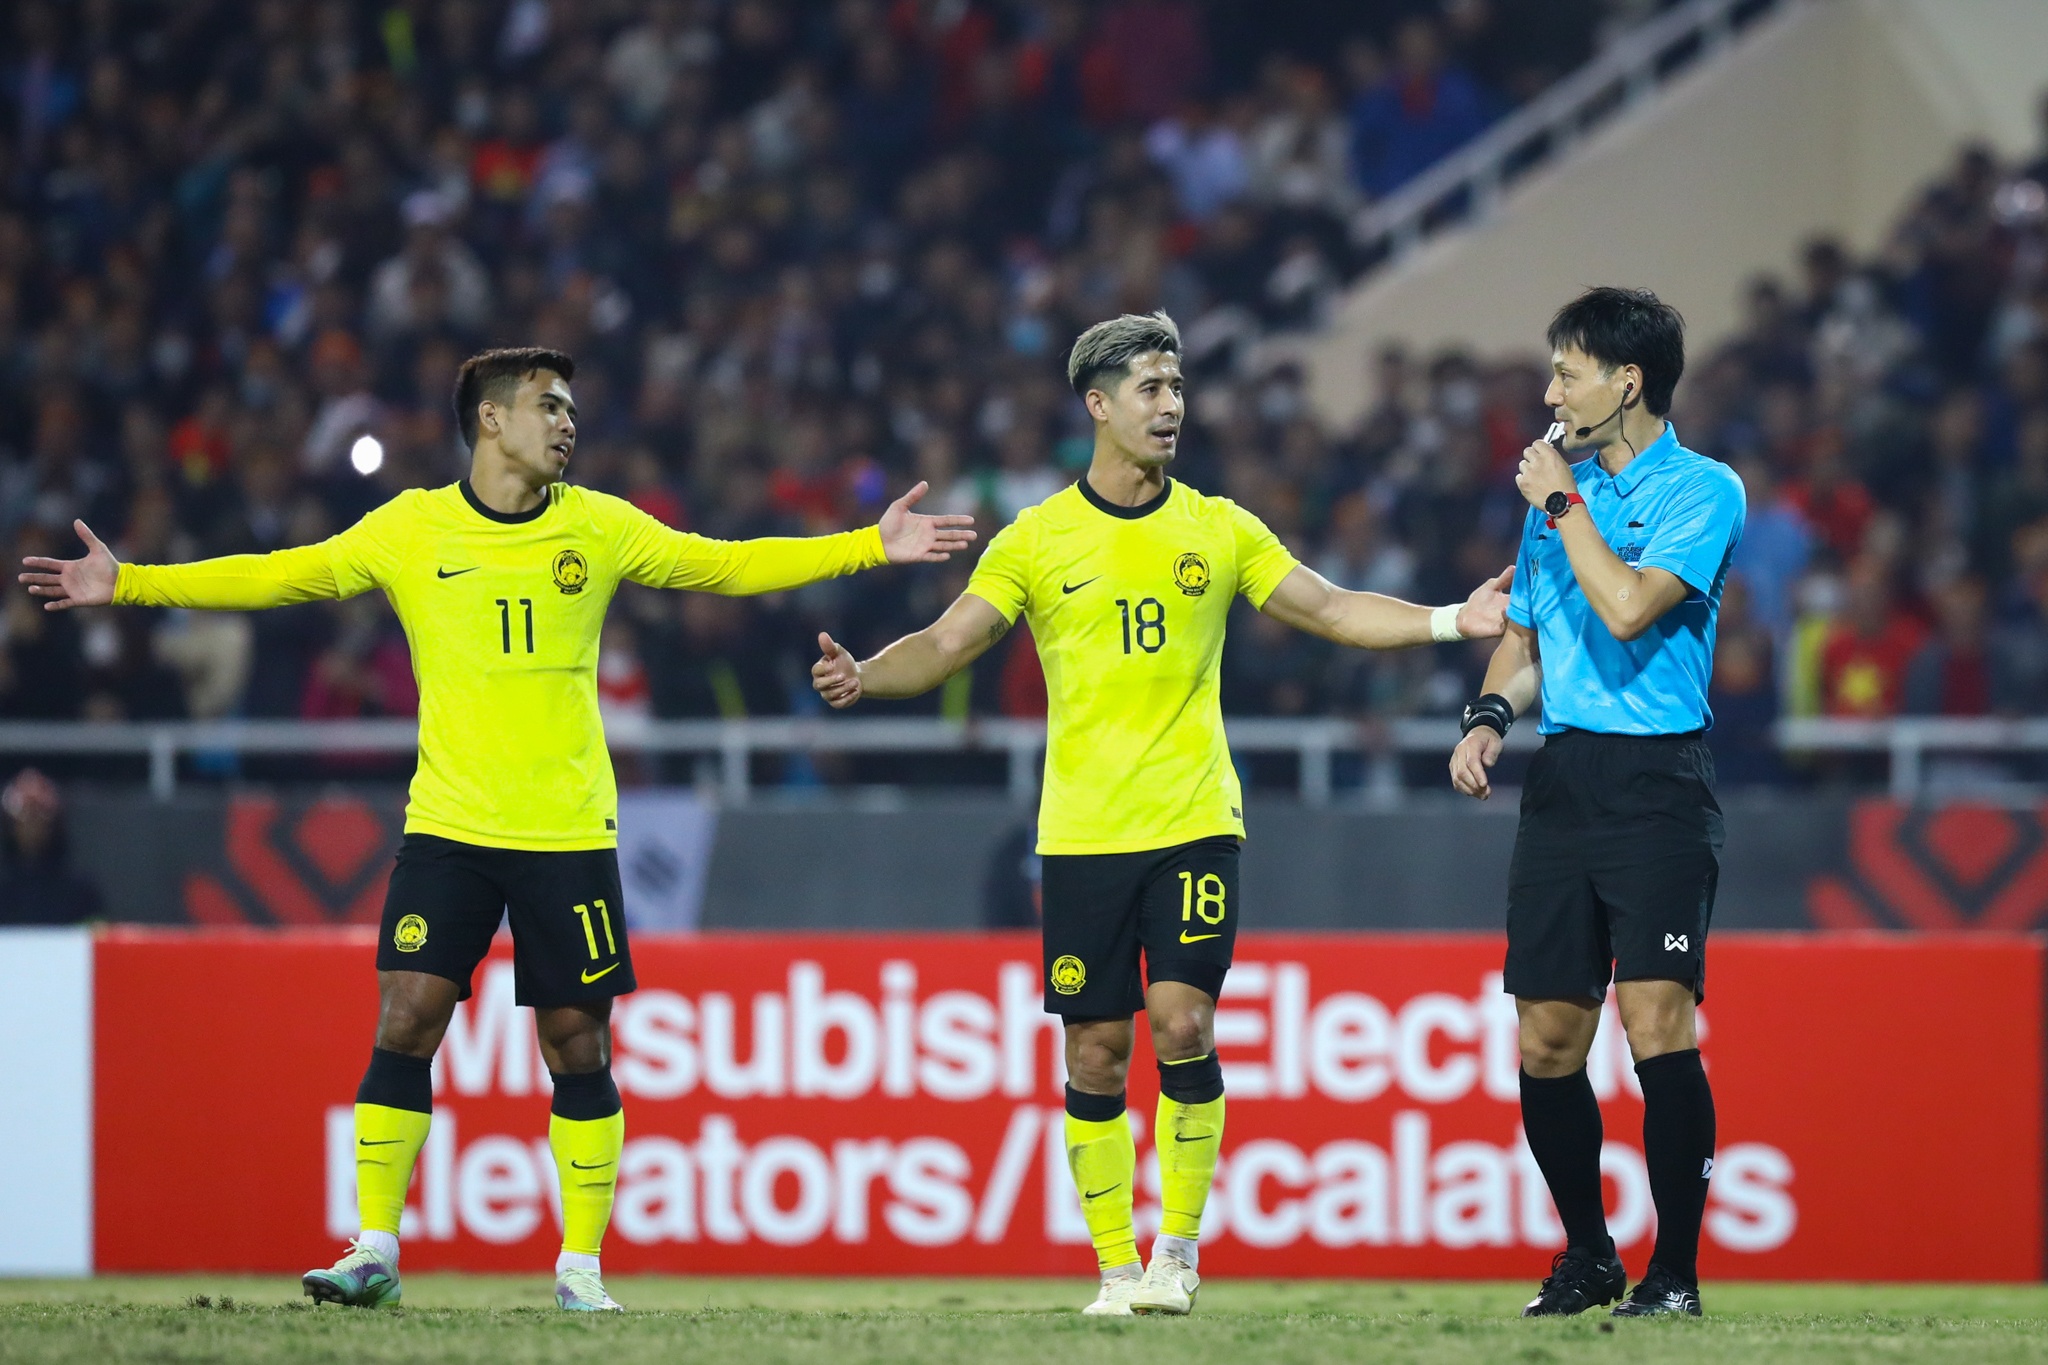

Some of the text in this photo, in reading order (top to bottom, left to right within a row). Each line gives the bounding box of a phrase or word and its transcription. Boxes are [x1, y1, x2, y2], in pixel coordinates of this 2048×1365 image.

[495, 598, 534, 654] 11
[1115, 597, 1166, 654] 18
[1178, 871, 1226, 925] 18
[572, 899, 616, 960] 11
[430, 960, 1708, 1102] Msubish Elect
[324, 1104, 1798, 1252] leators/Ecalatos
